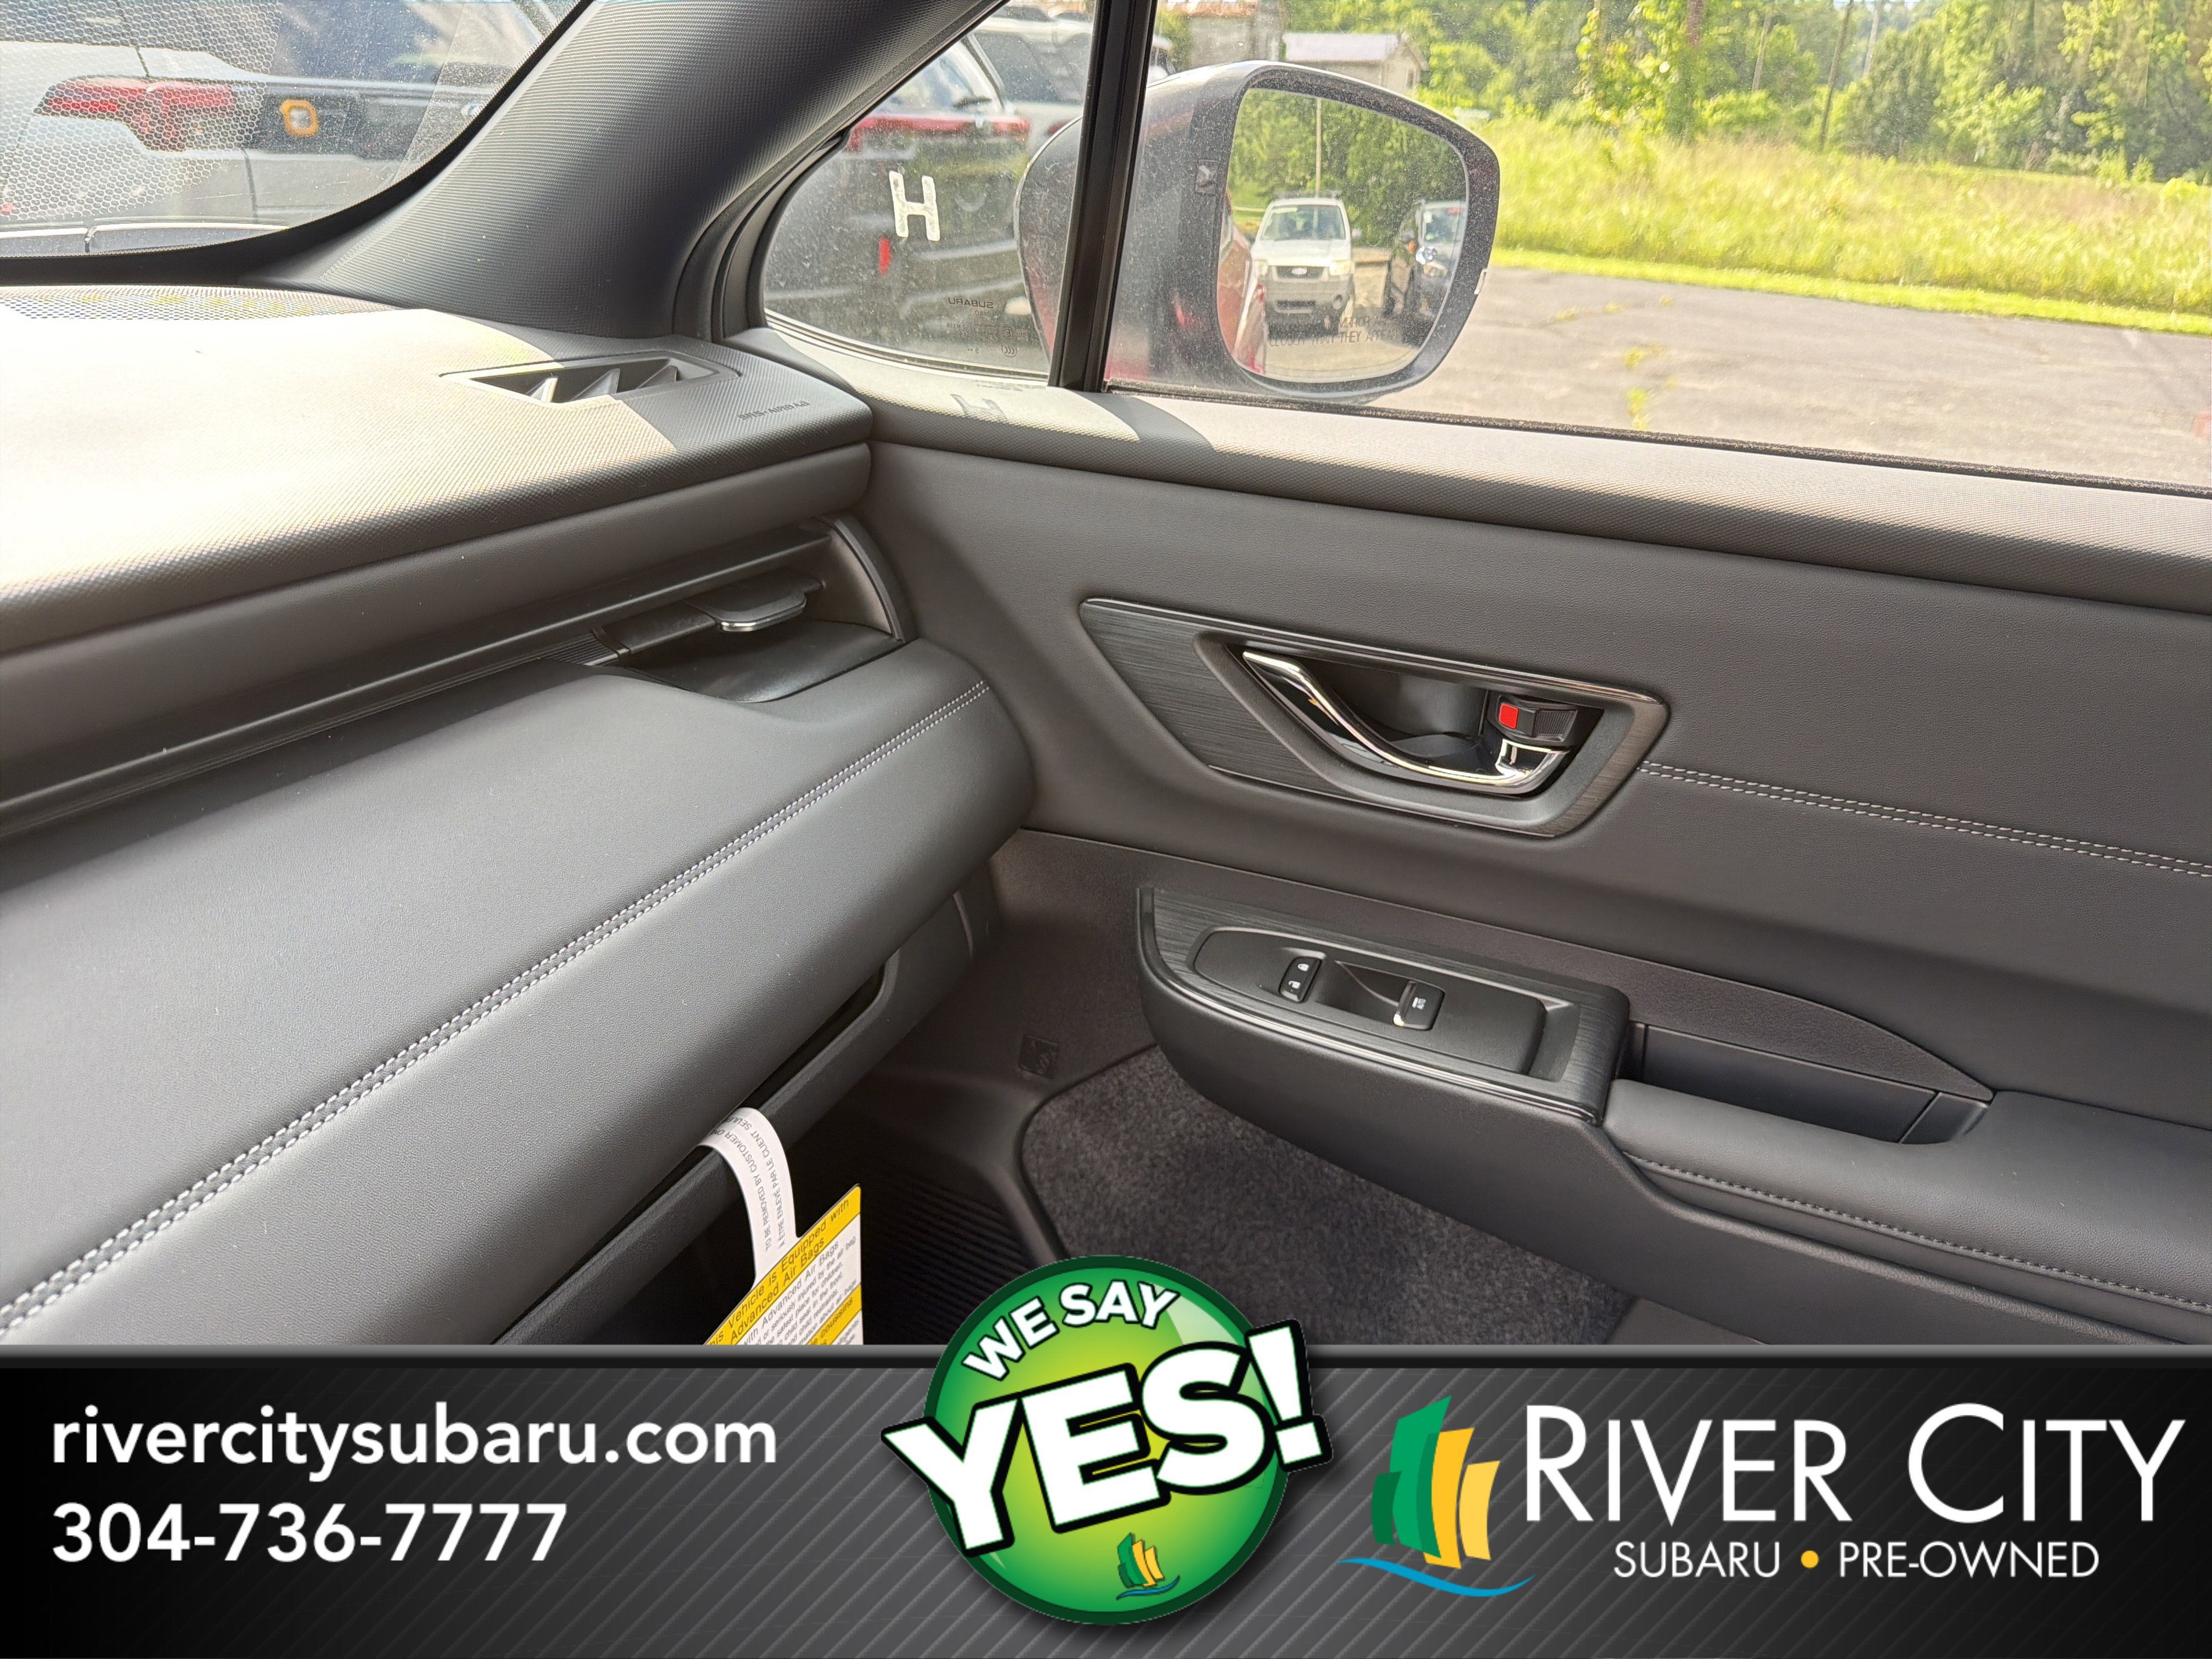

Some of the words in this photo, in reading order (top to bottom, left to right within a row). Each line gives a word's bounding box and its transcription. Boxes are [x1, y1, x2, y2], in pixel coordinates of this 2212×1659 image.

[889, 171, 940, 241] H
[1339, 330, 1362, 343] THEY
[725, 1131, 757, 1173] CUSTOMER
[750, 1131, 770, 1158] CLIENT
[766, 1158, 775, 1171] LE
[753, 1173, 761, 1187] BY
[770, 1170, 778, 1188] PAR
[758, 1186, 769, 1226] REMOVED
[764, 1224, 771, 1238] BE
[765, 1238, 772, 1251] TO
[729, 1285, 765, 1328] Vehicle
[769, 1272, 777, 1286] is
[781, 1221, 826, 1273] Equipped
[830, 1199, 849, 1222] with
[731, 1282, 779, 1345] Advanced
[783, 1266, 797, 1286] Air
[801, 1238, 825, 1267] Bags
[762, 1278, 802, 1329] Advanced
[804, 1264, 816, 1282] Air
[819, 1241, 839, 1266] Bags
